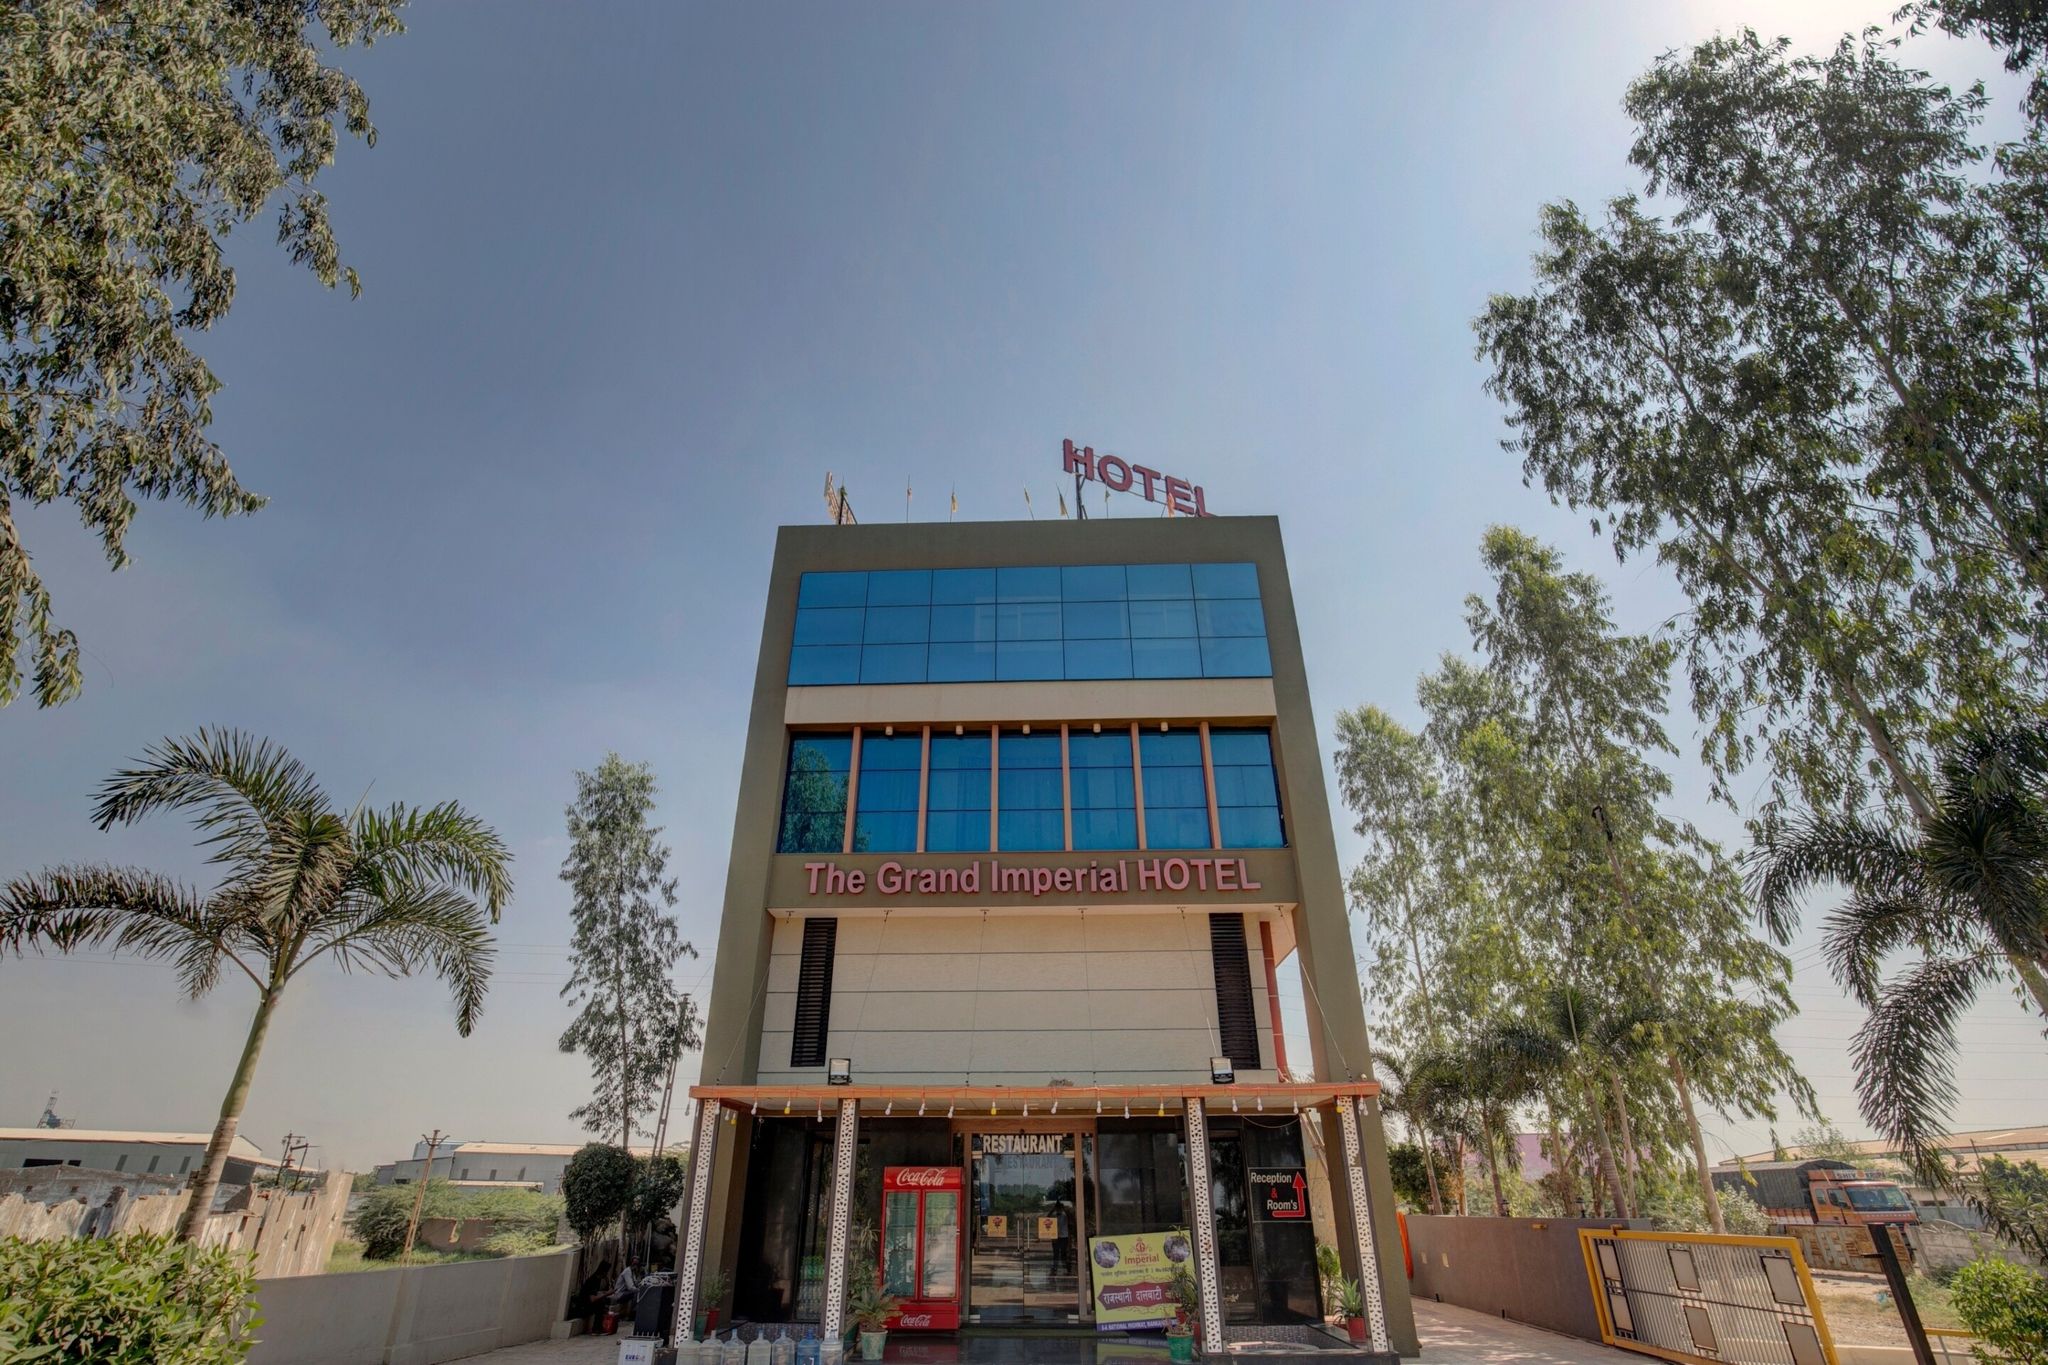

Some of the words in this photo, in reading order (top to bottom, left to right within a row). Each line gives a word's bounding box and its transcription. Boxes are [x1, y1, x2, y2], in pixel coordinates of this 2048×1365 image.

[1063, 438, 1217, 517] HOTEL
[804, 862, 866, 895] The
[877, 861, 980, 895] Grand
[991, 859, 1128, 896] Imperial
[1137, 857, 1262, 892] HOTEL
[982, 1134, 1063, 1154] RESTAURANT
[896, 1168, 947, 1186] Coca-Cola
[1250, 1172, 1292, 1186] Reception
[1270, 1187, 1278, 1199] &
[1266, 1199, 1298, 1210] Room's
[1124, 1253, 1160, 1266] Imperial
[900, 1314, 932, 1327] Coca-Cola
